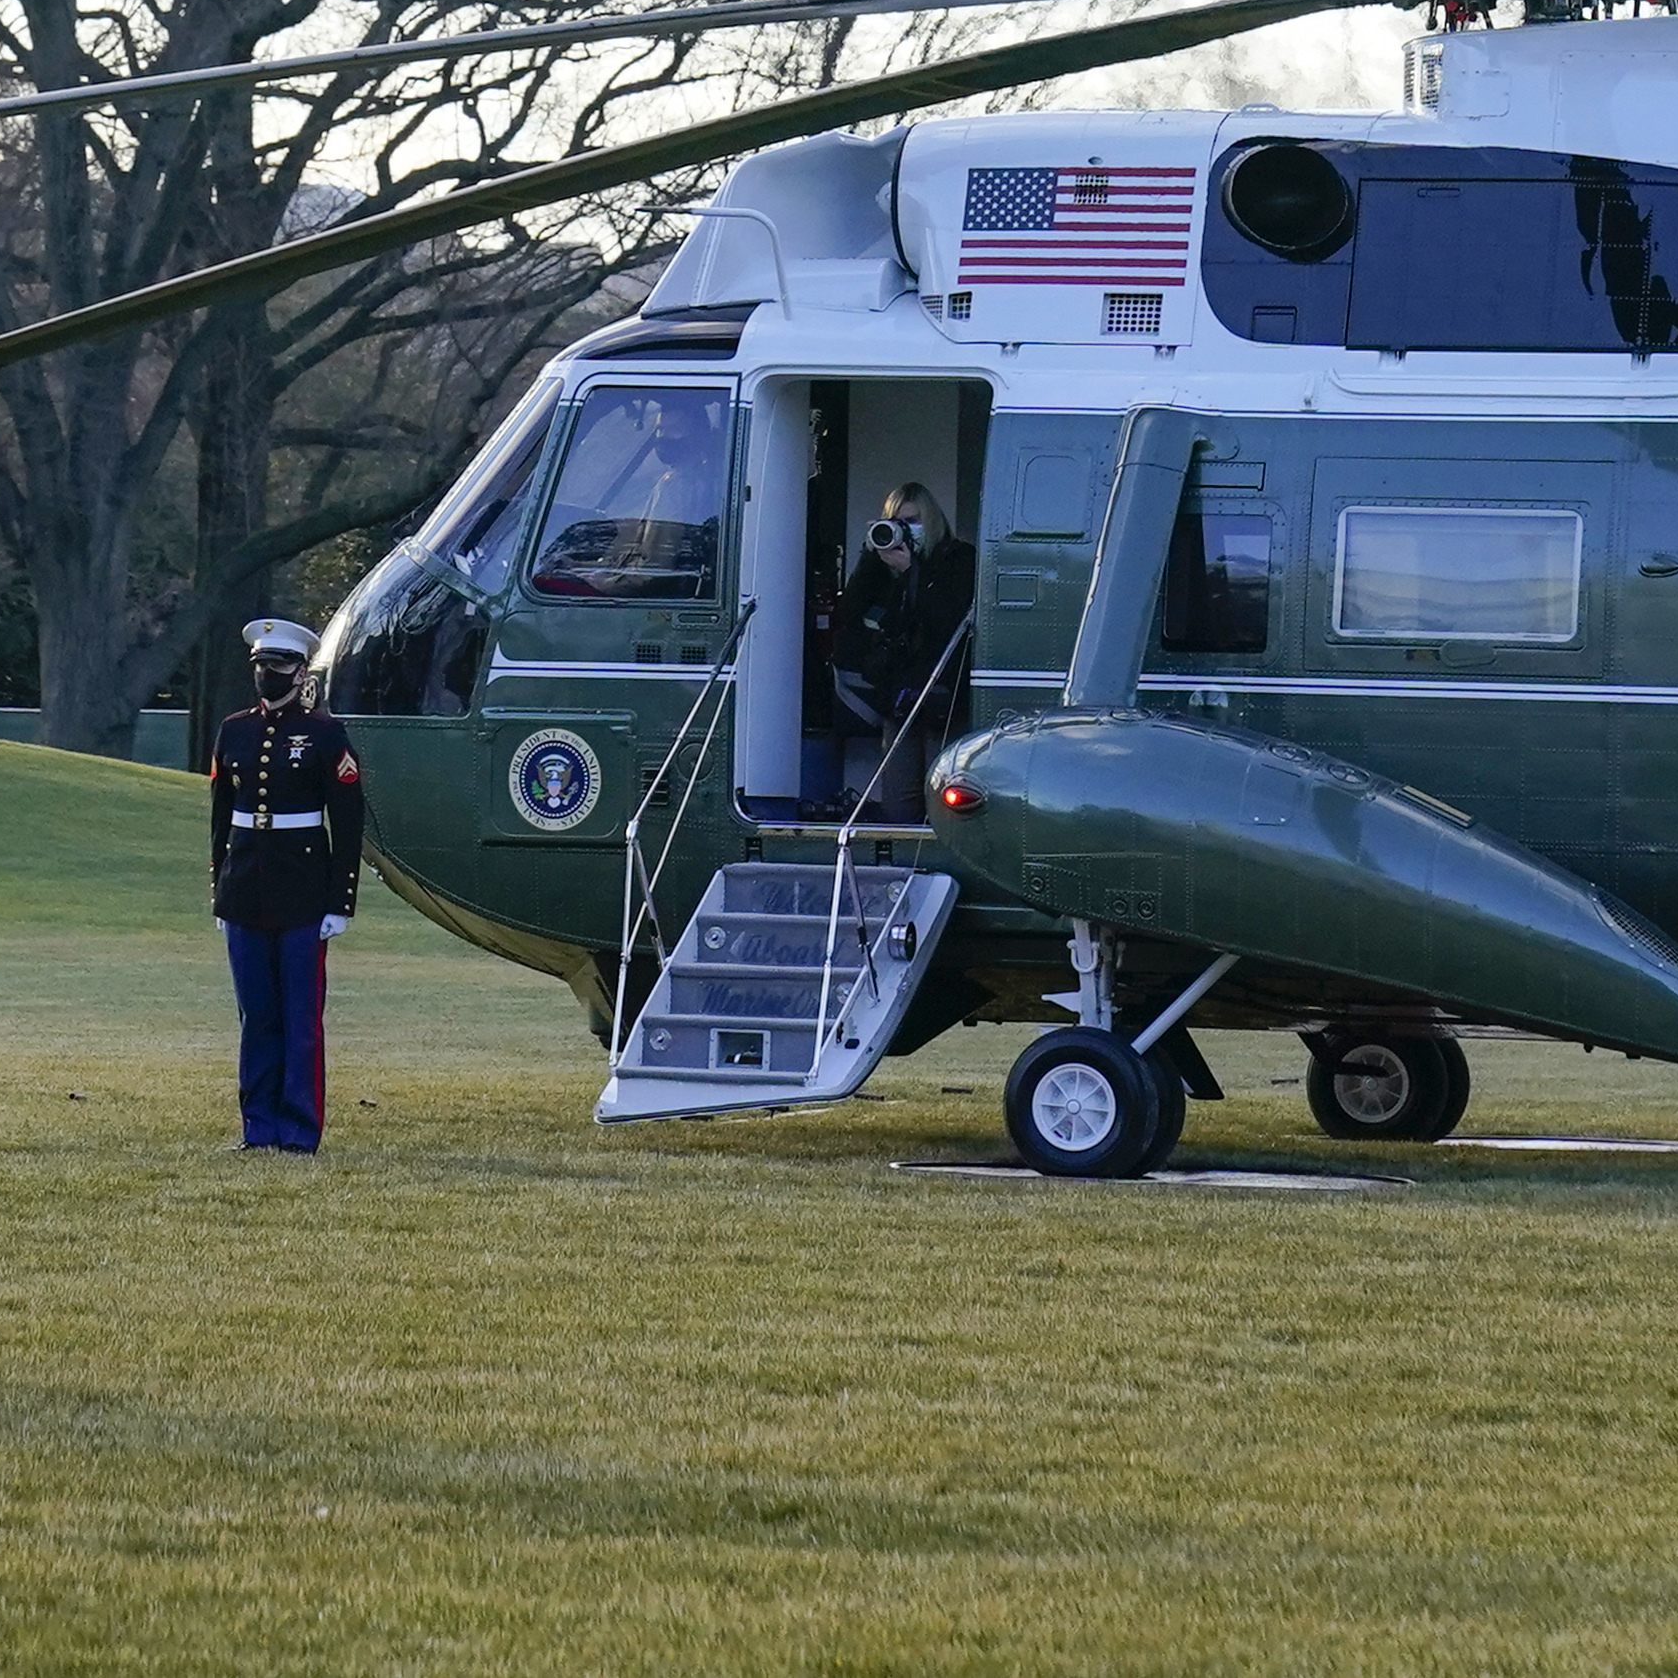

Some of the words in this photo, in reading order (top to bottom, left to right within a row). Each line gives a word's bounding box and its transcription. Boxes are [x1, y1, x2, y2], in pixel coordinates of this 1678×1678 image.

[512, 730, 557, 775] PRESIDENT
[582, 748, 600, 795] UNITED
[523, 808, 546, 827] SEAL
[561, 797, 595, 827] STATES
